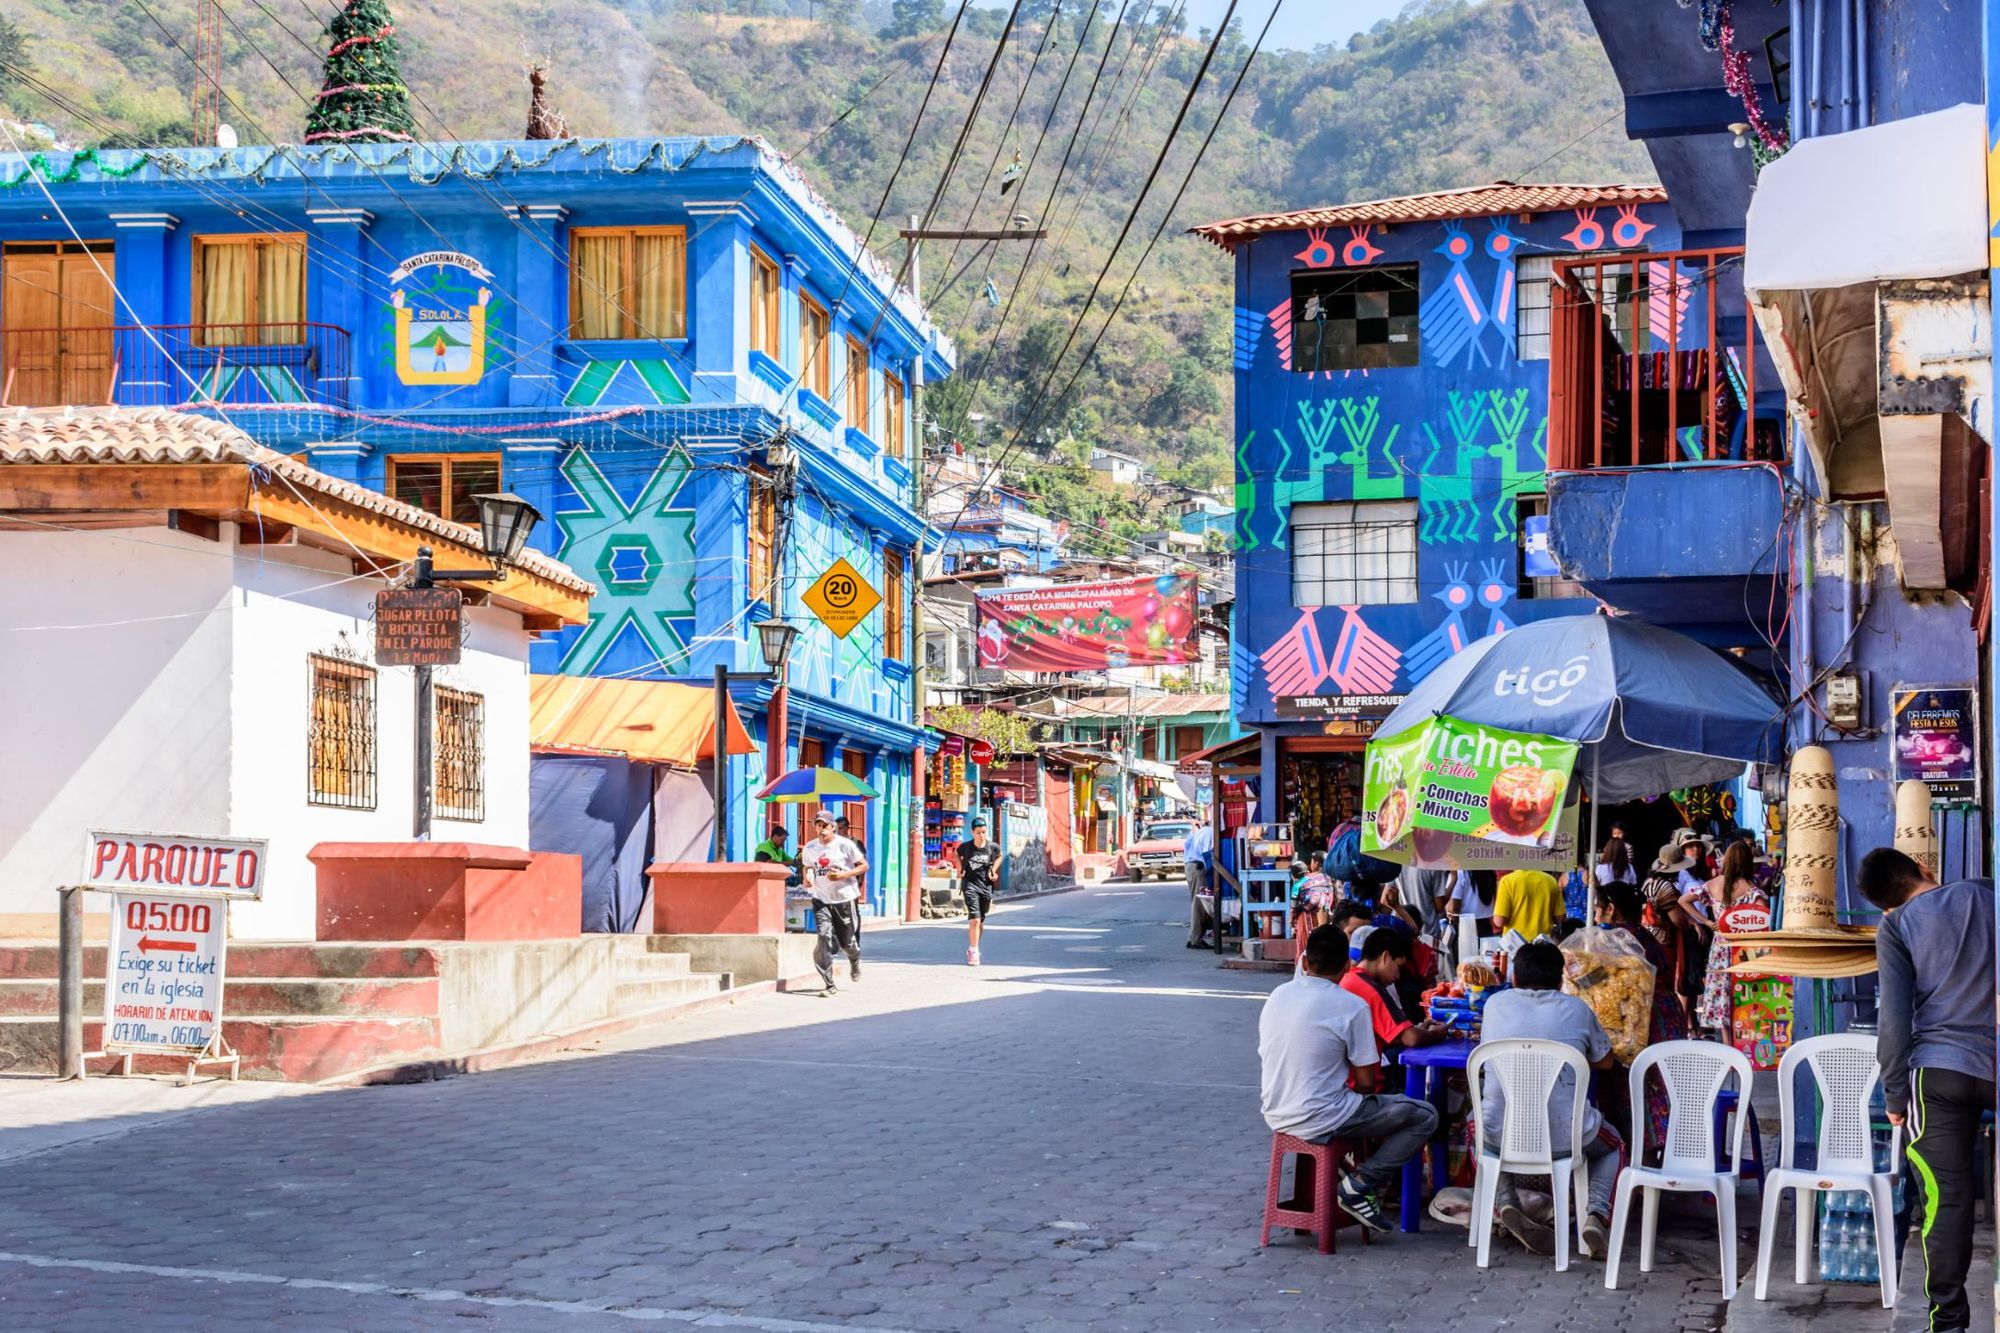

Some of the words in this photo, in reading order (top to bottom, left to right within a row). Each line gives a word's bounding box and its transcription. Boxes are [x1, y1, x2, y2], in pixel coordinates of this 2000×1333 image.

[403, 257, 424, 272] SANTA
[423, 253, 454, 264] CATARINA
[829, 581, 852, 595] 20
[1002, 593, 1012, 601] TE
[1041, 592, 1052, 600] LA
[1124, 588, 1135, 597] DE
[1003, 603, 1031, 611] SANTA
[1032, 602, 1076, 611] CATARINA
[377, 609, 412, 621] JUGAR
[415, 609, 458, 621] PELOTA
[379, 623, 385, 635] Y
[389, 623, 447, 636] BICICLETA
[377, 637, 391, 649] EN
[393, 637, 408, 649] EL
[411, 637, 454, 649] PARQUE
[1294, 697, 1329, 708] TIENDA
[1332, 697, 1341, 706] Y
[1343, 695, 1408, 706] REFRESQUER
[1910, 719, 1932, 728] FIESTA
[972, 749, 990, 757] Claro
[1437, 758, 1478, 779] Estela
[1426, 783, 1489, 808] Conchas
[1422, 799, 1471, 822] Mixtos
[93, 840, 258, 889] PARQUEO
[1732, 914, 1765, 925] Sarita
[118, 951, 155, 980] Exige
[157, 959, 172, 972] su
[178, 953, 216, 975] ticket
[121, 982, 138, 994] en
[145, 977, 155, 995] la
[161, 978, 204, 1004] iglesia
[114, 1005, 153, 1020] HORARIO
[155, 1007, 167, 1020] DE
[169, 1008, 214, 1023] ATENCION
[160, 1033, 167, 1043] a
